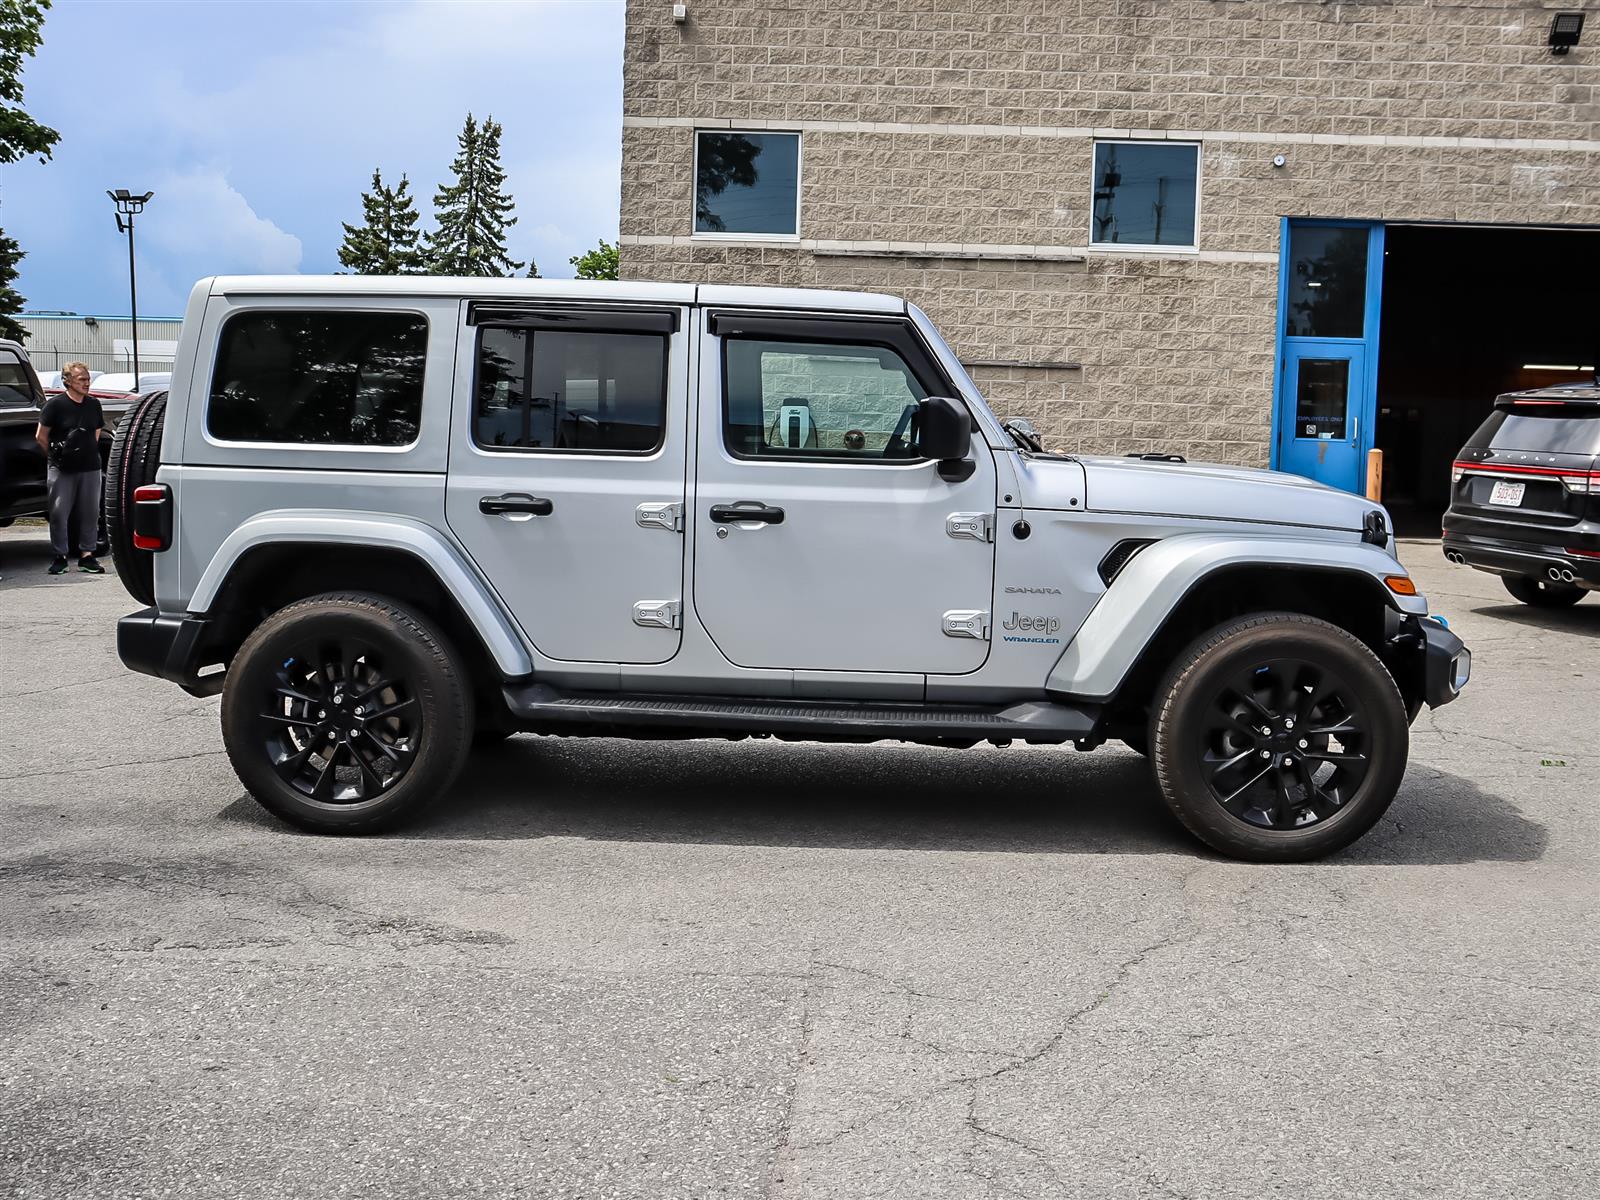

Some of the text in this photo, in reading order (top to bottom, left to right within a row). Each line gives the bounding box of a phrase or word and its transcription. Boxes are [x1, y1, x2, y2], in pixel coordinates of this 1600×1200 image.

[1004, 586, 1062, 595] SAHARA
[1002, 611, 1060, 635] Jeep
[1003, 636, 1060, 644] WRANGLER
